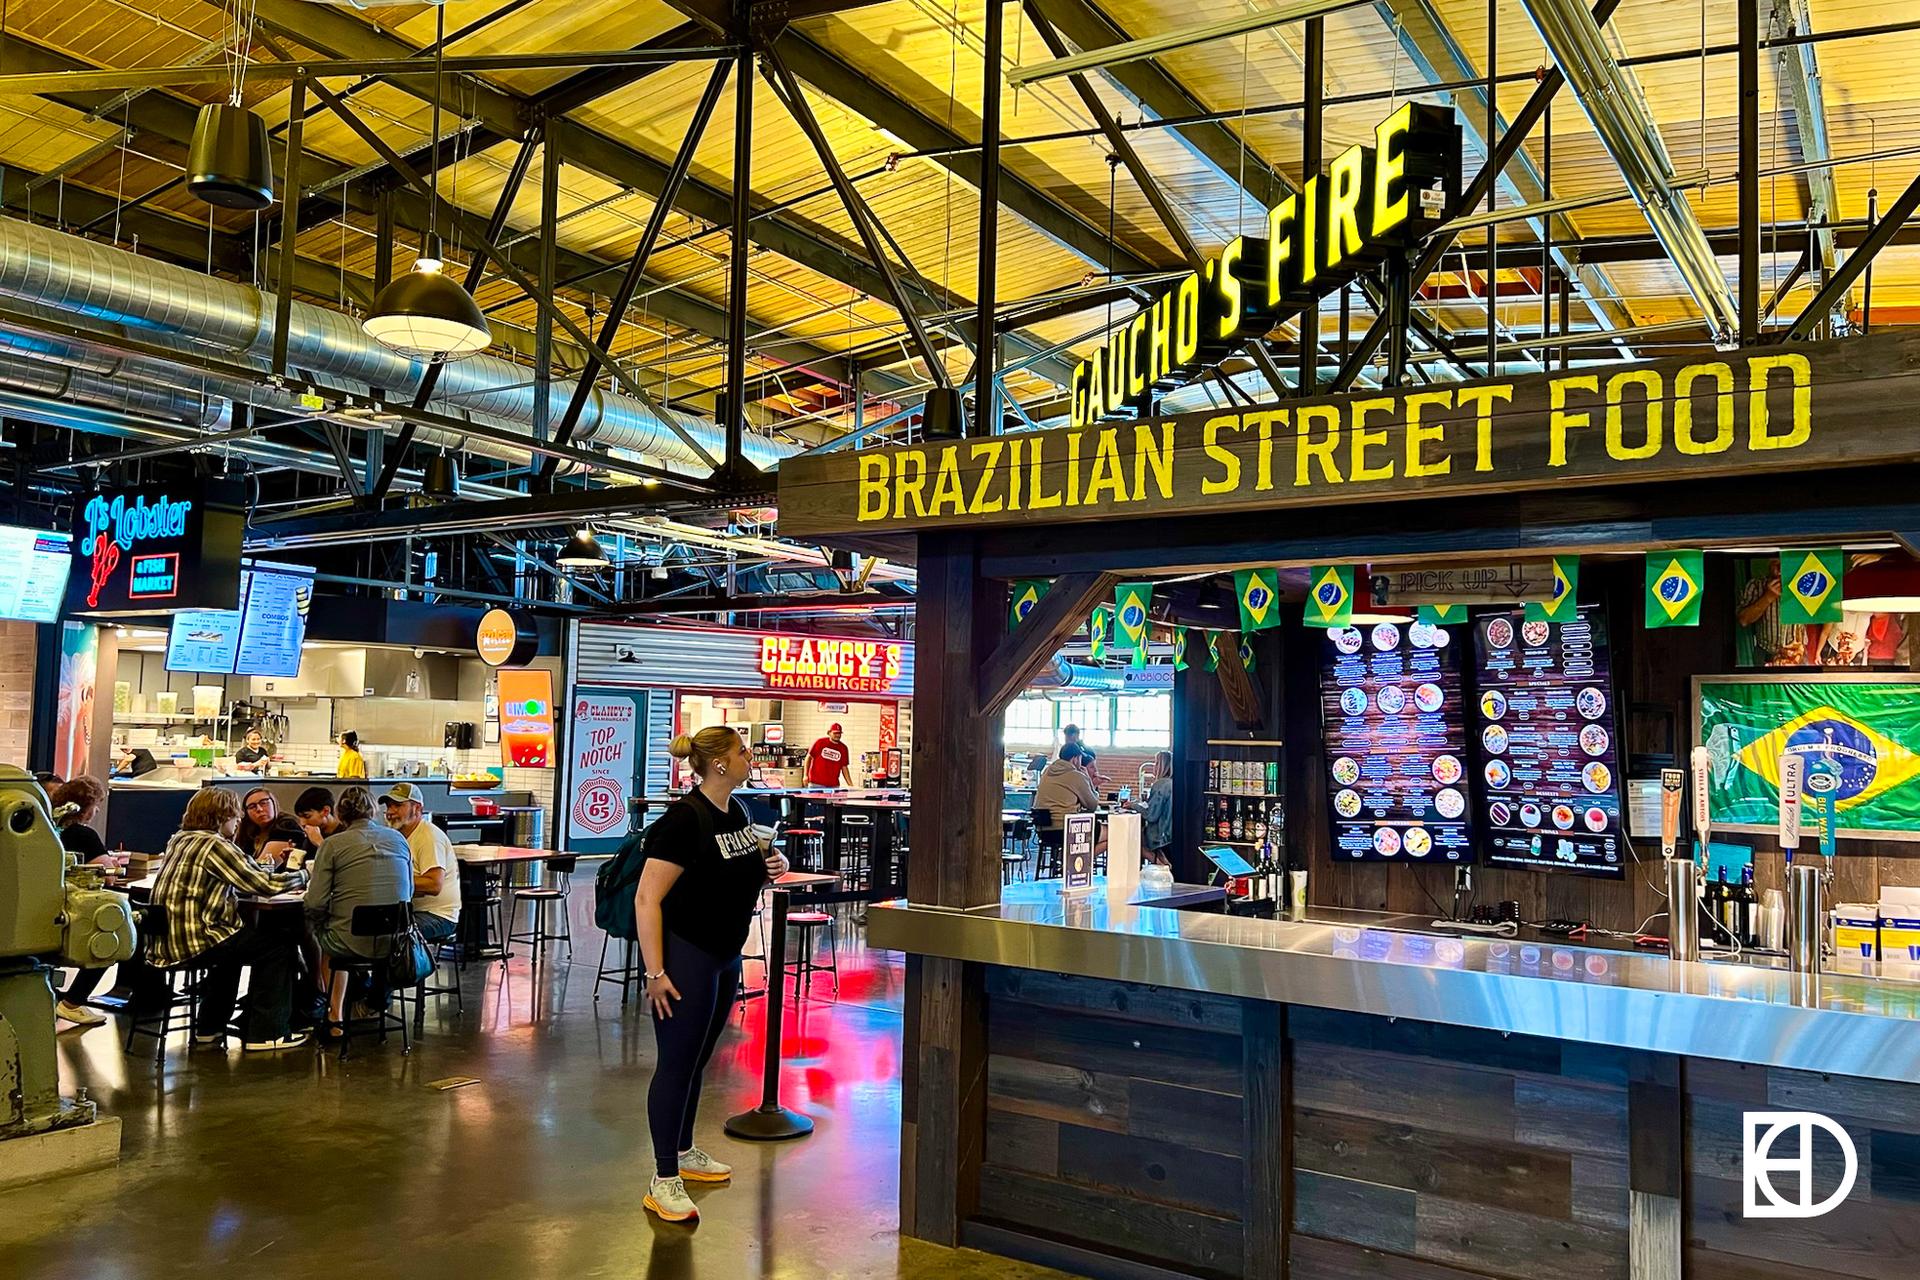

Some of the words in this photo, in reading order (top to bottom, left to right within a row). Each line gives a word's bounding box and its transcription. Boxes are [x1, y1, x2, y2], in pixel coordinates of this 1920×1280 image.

[1071, 235, 1243, 427] GAUCHO'S
[1268, 101, 1411, 307] FIRE
[857, 422, 1177, 522] BRAZILIAN
[1202, 384, 1514, 495] STREET
[1547, 353, 1812, 467] FOOD
[82, 495, 109, 556] J's
[110, 495, 192, 550] Lobster
[133, 575, 174, 592] MARKET
[1400, 570, 1454, 592] PICK
[1463, 569, 1498, 590] UP
[761, 636, 901, 679] CLANCY'S
[770, 673, 892, 692] HAMBURGERS
[591, 704, 632, 717] CLANCY'S
[1786, 763, 1797, 797] ULTRA
[591, 791, 609, 806] 19
[1818, 797, 1827, 814] BIG
[589, 804, 610, 819] 65
[1819, 817, 1829, 846] WAVE
